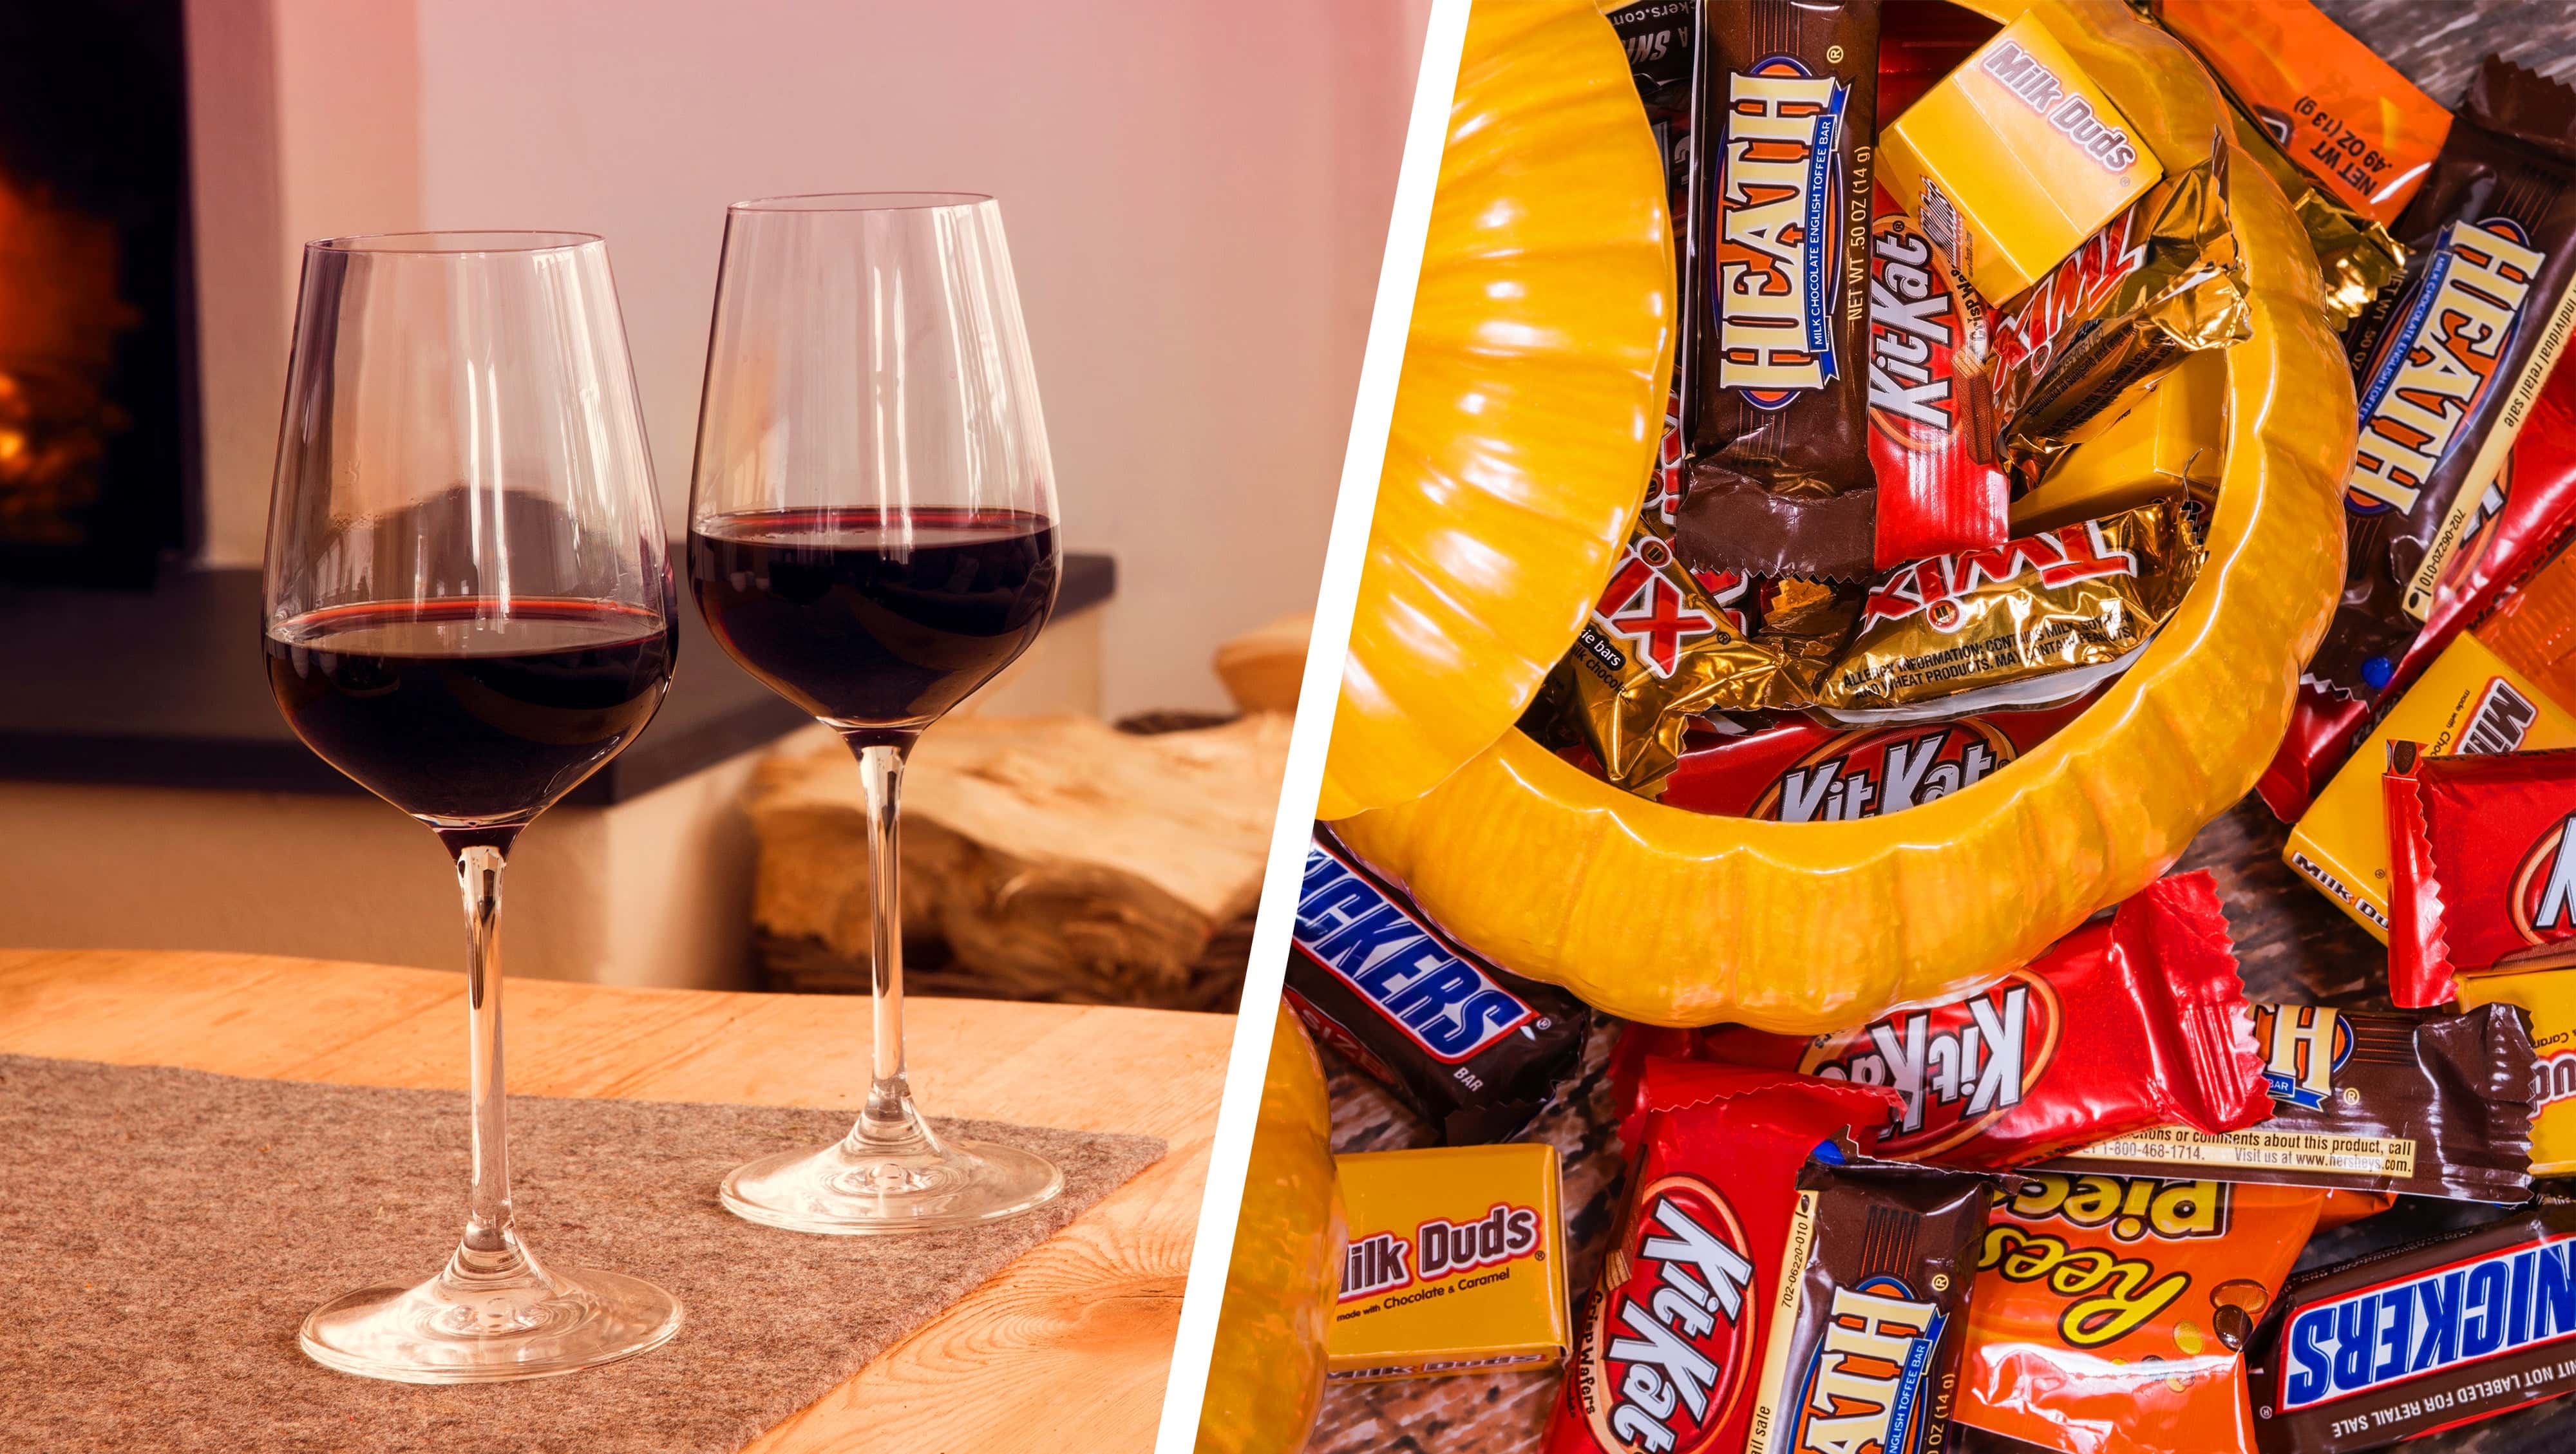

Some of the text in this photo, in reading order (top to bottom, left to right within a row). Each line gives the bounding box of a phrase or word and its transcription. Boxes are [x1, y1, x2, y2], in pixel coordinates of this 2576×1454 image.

[1985, 44, 2135, 169] Milk Duds
[2293, 95, 2392, 173] .49 OZ (13 g)
[2309, 140, 2378, 196] NET WT
[1720, 72, 1835, 390] HEATH
[1810, 121, 1831, 345] MILK CHOCOLATE ENGLISH TOFFEE BAR
[1848, 146, 1871, 321] NET WT .50 OZ (14 g)
[2430, 256, 2446, 281] MILK
[1870, 233, 1950, 431] KitKat
[2402, 281, 2437, 341] CHOCOLATE
[2349, 221, 2546, 515] HEATH
[2378, 341, 2408, 386] ENGLISH
[2519, 363, 2543, 401] retail
[2503, 398, 2524, 428] sale
[2419, 508, 2467, 587] 702-06220-010
[1593, 639, 1621, 666] bars
[1926, 657, 1994, 684] PRODUCTS.
[2455, 688, 2470, 712] made
[2295, 853, 2351, 902] Milk
[1453, 1066, 1484, 1093] BAR
[2175, 1130, 2188, 1142] or
[2264, 1133, 2300, 1149] about
[2304, 1135, 2328, 1151] this
[2331, 1138, 2384, 1156] product,
[2387, 1141, 2411, 1156] call
[2233, 1147, 2261, 1163] Visit
[2264, 1151, 2278, 1164] us
[2280, 1151, 2293, 1165] at
[2296, 1153, 2412, 1173] www.hersheys.com.
[1421, 1207, 1533, 1274] Duds
[1781, 1222, 1810, 1309] 702-06220-010
[1336, 1267, 1510, 1321] made with Chocolate & Caramel
[1608, 1197, 1754, 1453] KitKat
[2287, 1240, 2576, 1406] NICKERS
[1580, 1345, 1596, 1415] Wafers
[1899, 1370, 1918, 1410] TOFFEE
[1911, 1345, 1926, 1368] BAR
[1942, 1373, 1956, 1389] g)
[2456, 1374, 2521, 1404] LABELED
[2524, 1364, 2555, 1386] NOT
[1756, 1405, 1770, 1437] sale
[1933, 1393, 1950, 1419] (14
[2371, 1400, 2422, 1427] RETAIL
[2423, 1393, 2454, 1413] FOR
[1928, 1423, 1944, 1442] OZ
[2331, 1414, 2369, 1439] SALE
